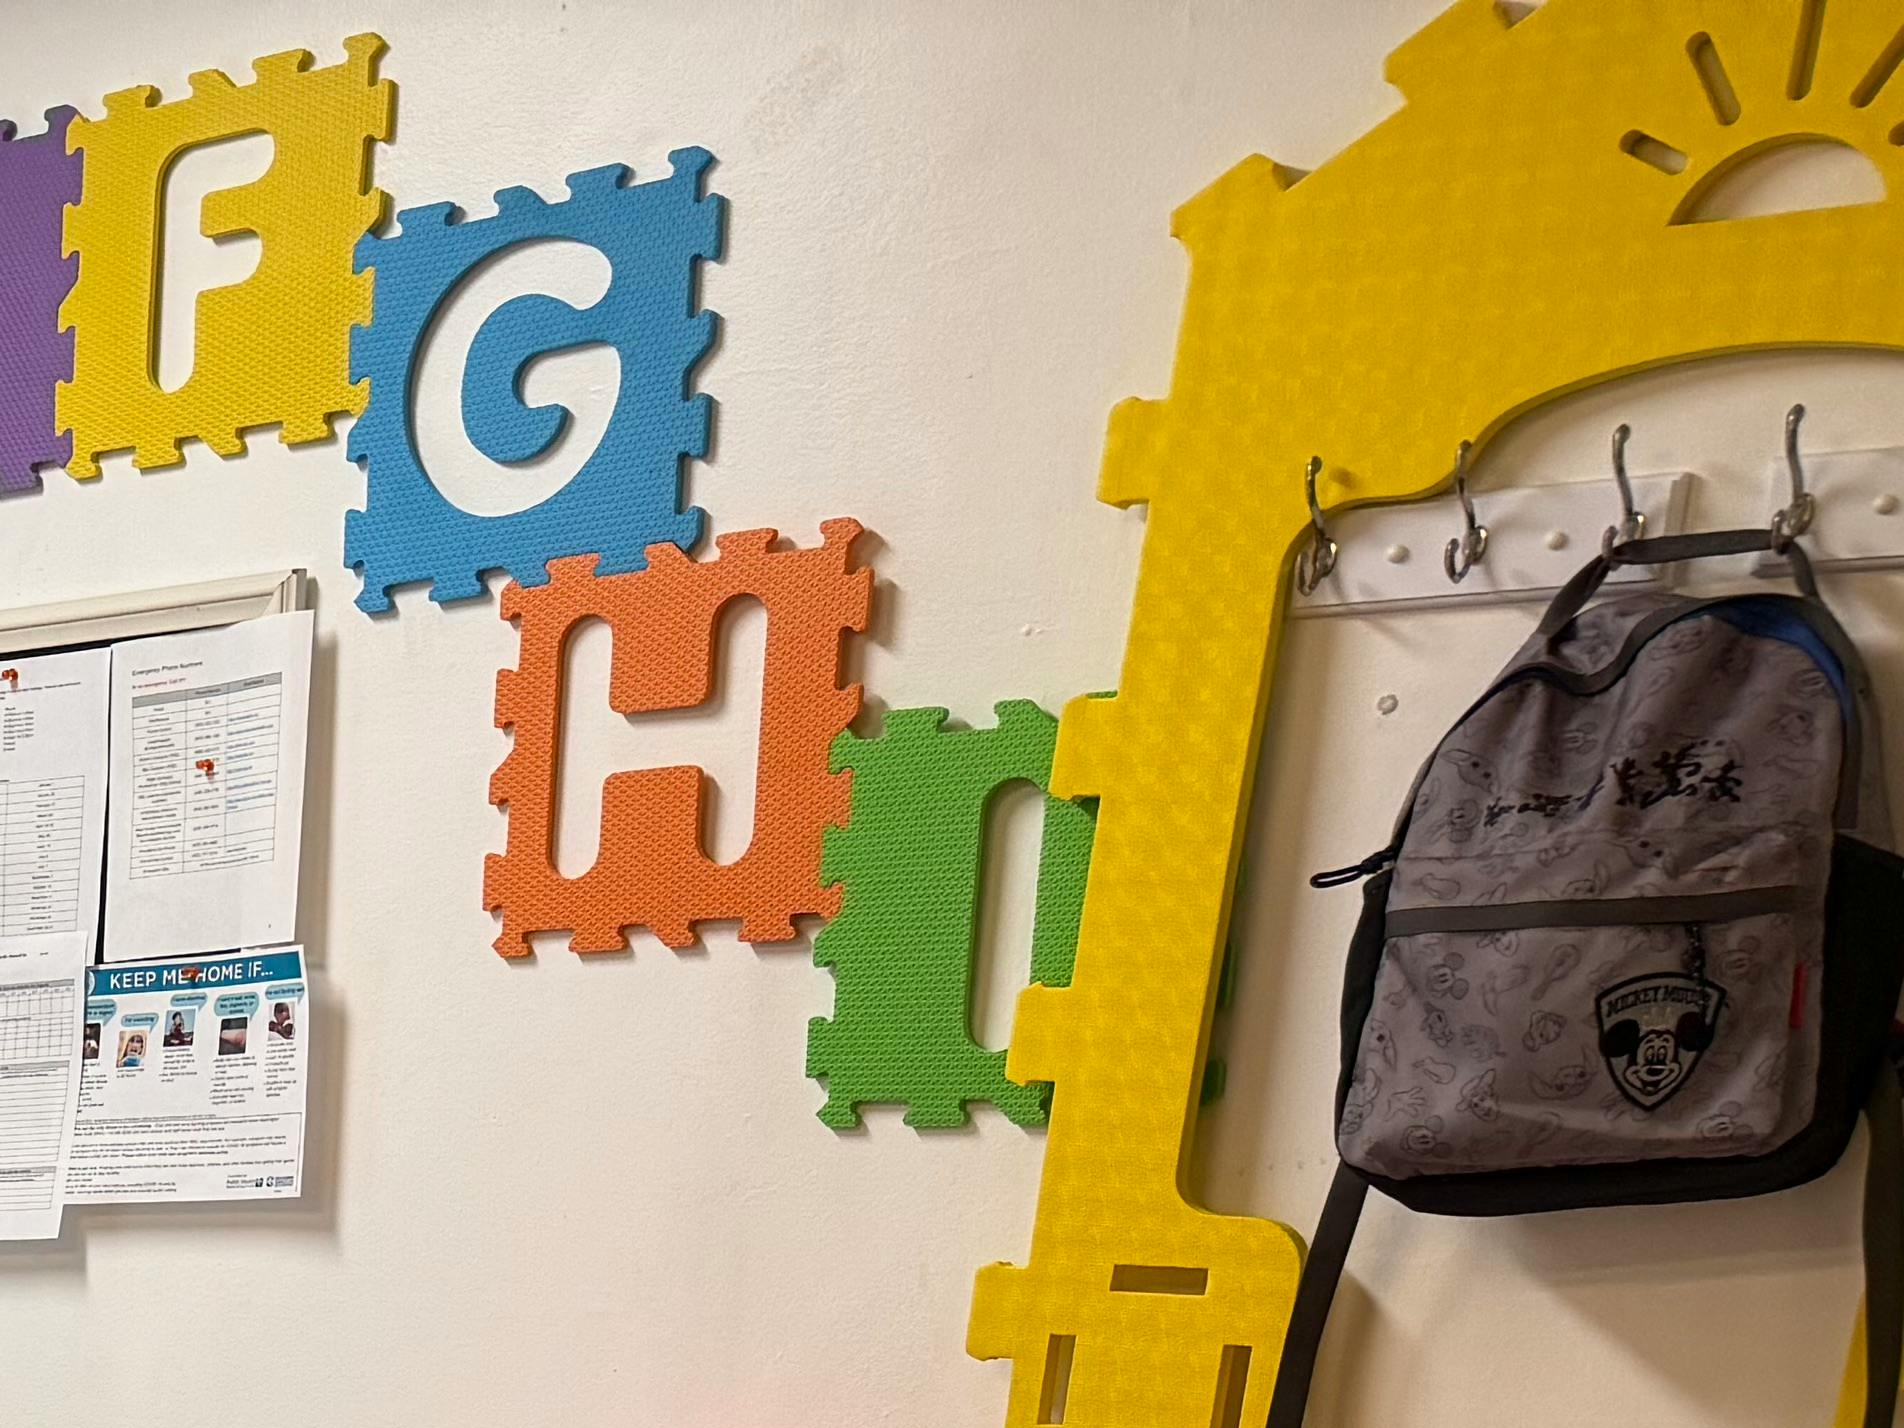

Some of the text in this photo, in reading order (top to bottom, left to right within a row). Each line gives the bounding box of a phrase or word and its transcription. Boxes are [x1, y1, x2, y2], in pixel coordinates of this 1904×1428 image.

[154, 131, 279, 392] F
[412, 235, 621, 519] G
[553, 595, 767, 877] H
[110, 961, 274, 990] KEEP ME HOME IF...
